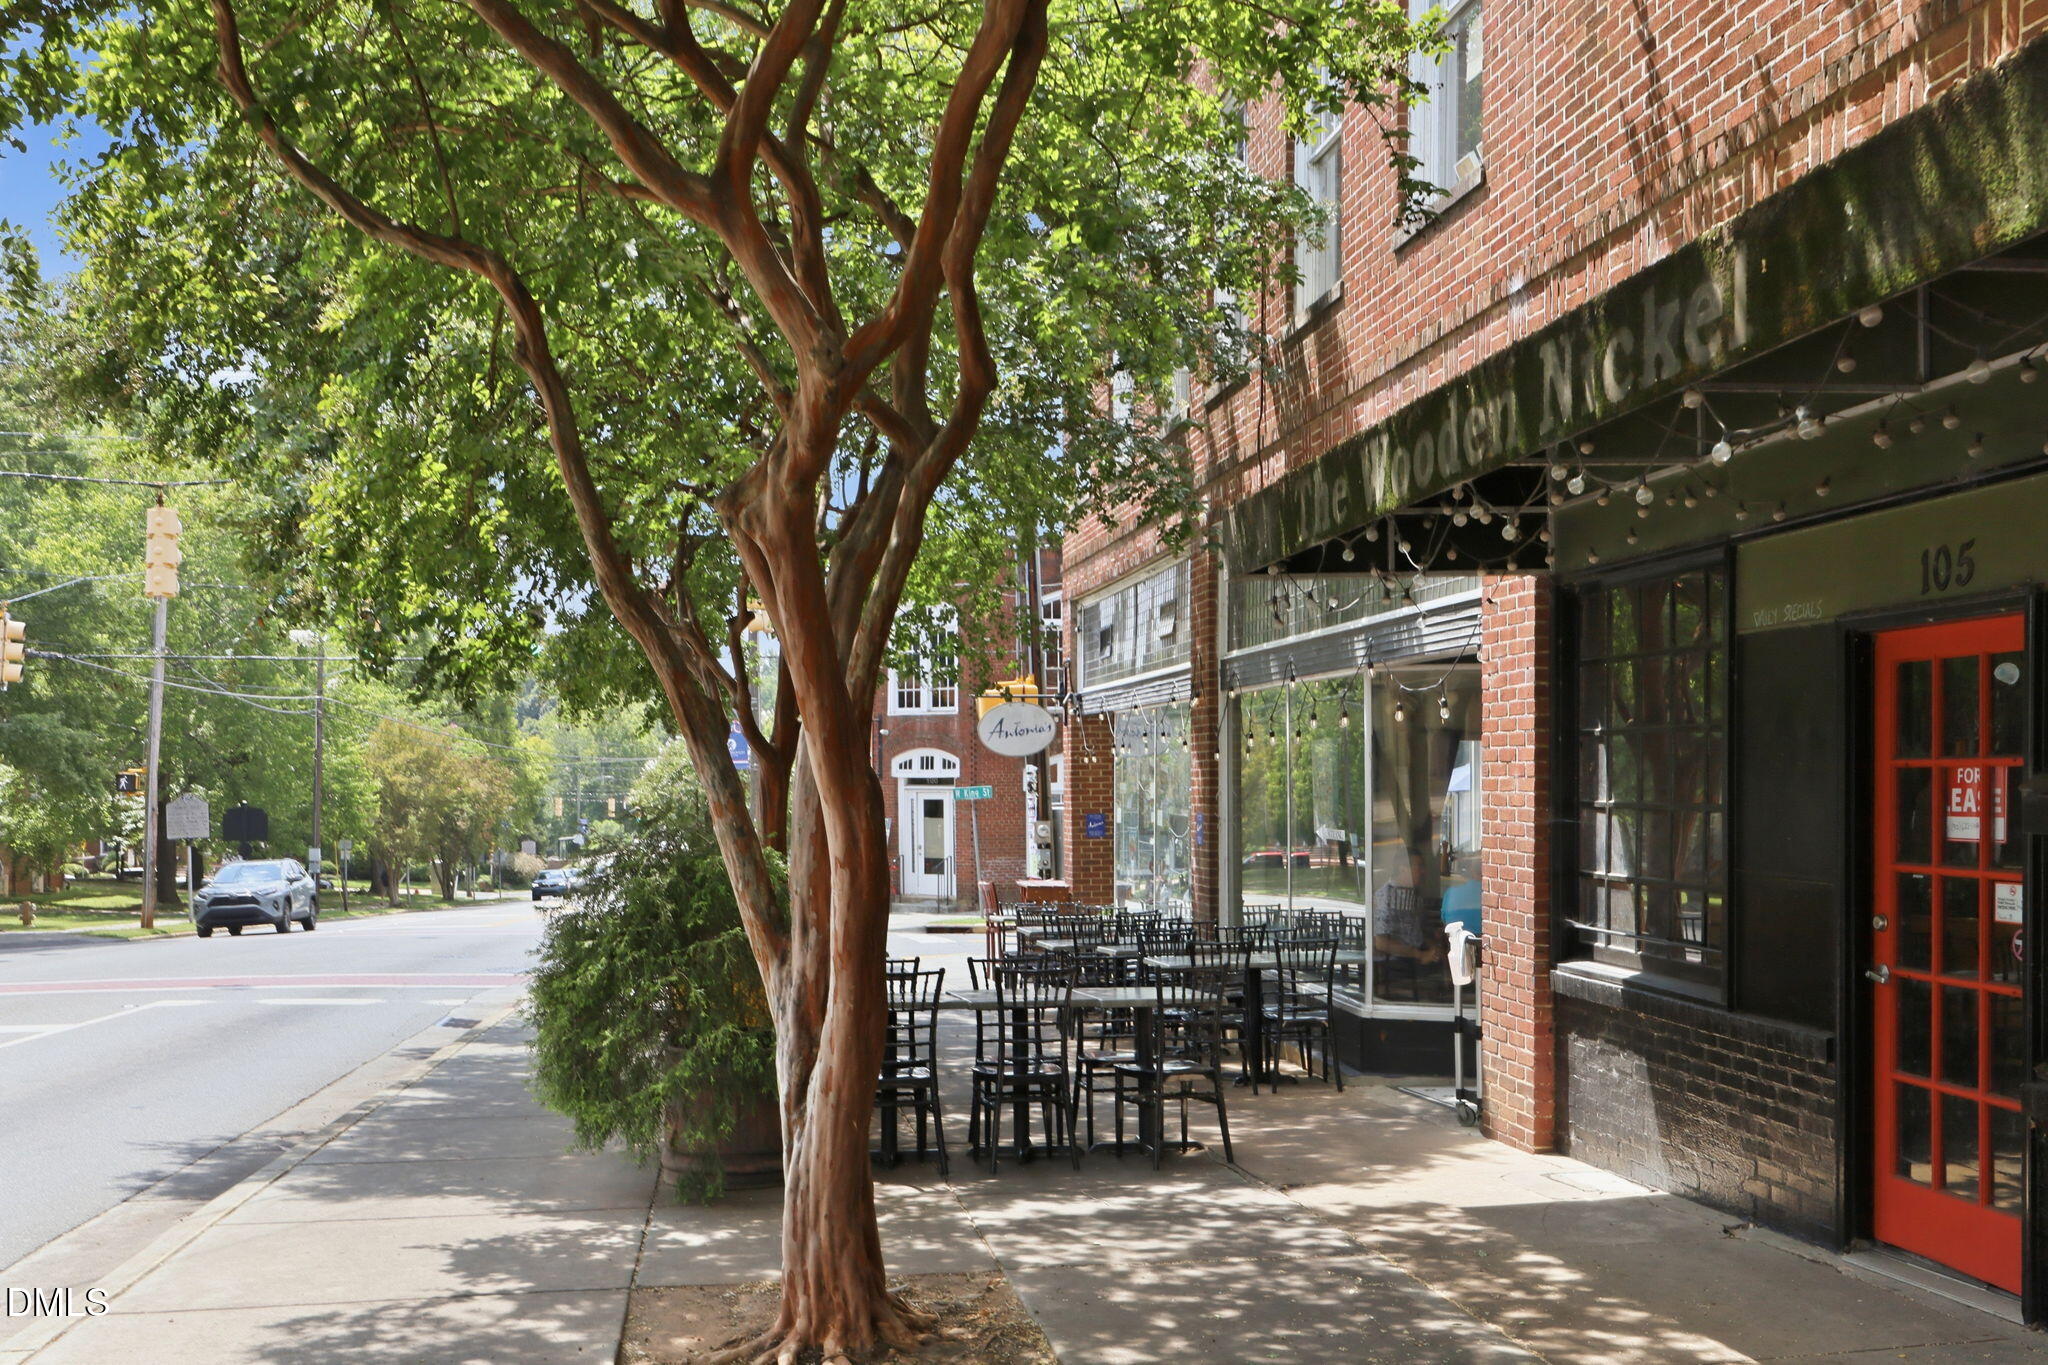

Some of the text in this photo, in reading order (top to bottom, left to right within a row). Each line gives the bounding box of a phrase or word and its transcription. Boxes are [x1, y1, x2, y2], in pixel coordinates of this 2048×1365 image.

[1296, 240, 1748, 541] The Wooden Nickel
[1921, 538, 1976, 595] 105
[1957, 767, 1980, 784] FOR
[963, 788, 979, 799] King
[982, 787, 990, 798] St
[1947, 788, 2002, 813] EAE
